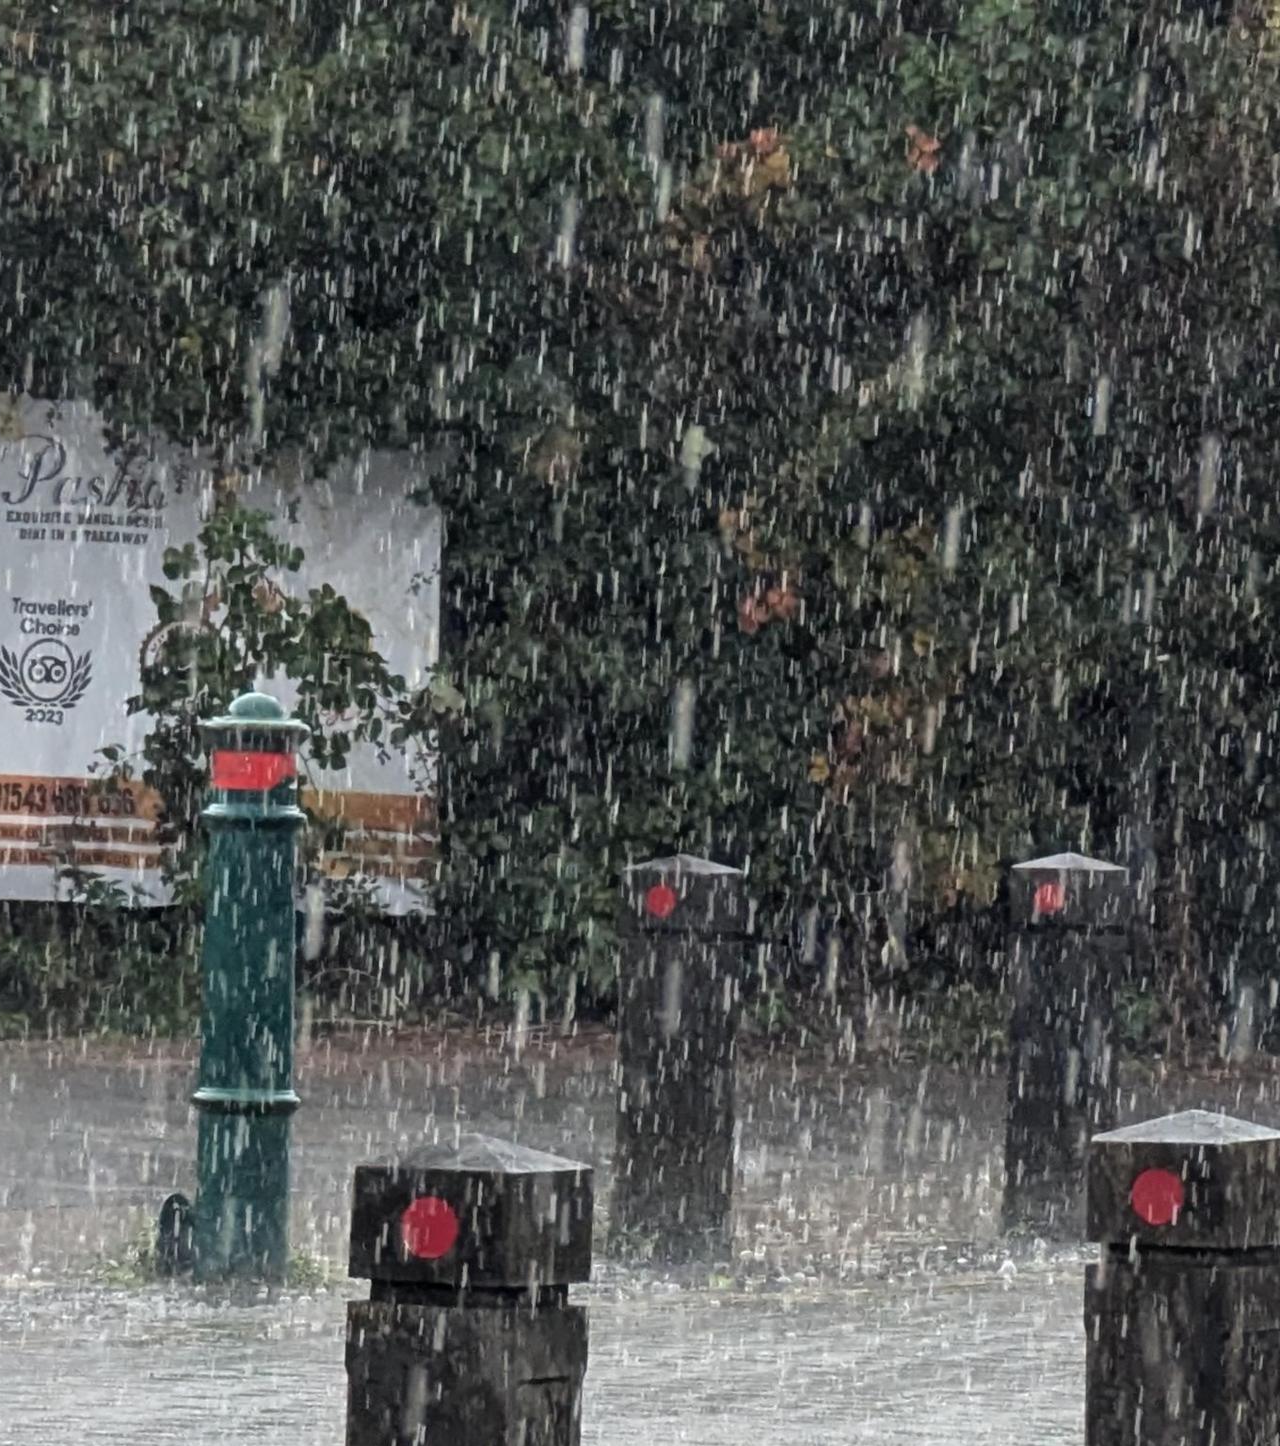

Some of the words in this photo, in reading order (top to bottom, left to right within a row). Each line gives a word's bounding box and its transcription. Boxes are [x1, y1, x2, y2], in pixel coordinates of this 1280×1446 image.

[1, 434, 168, 512] Pasha
[12, 597, 92, 618] Travellers'
[20, 618, 80, 636] Choice
[24, 708, 64, 726] 2023
